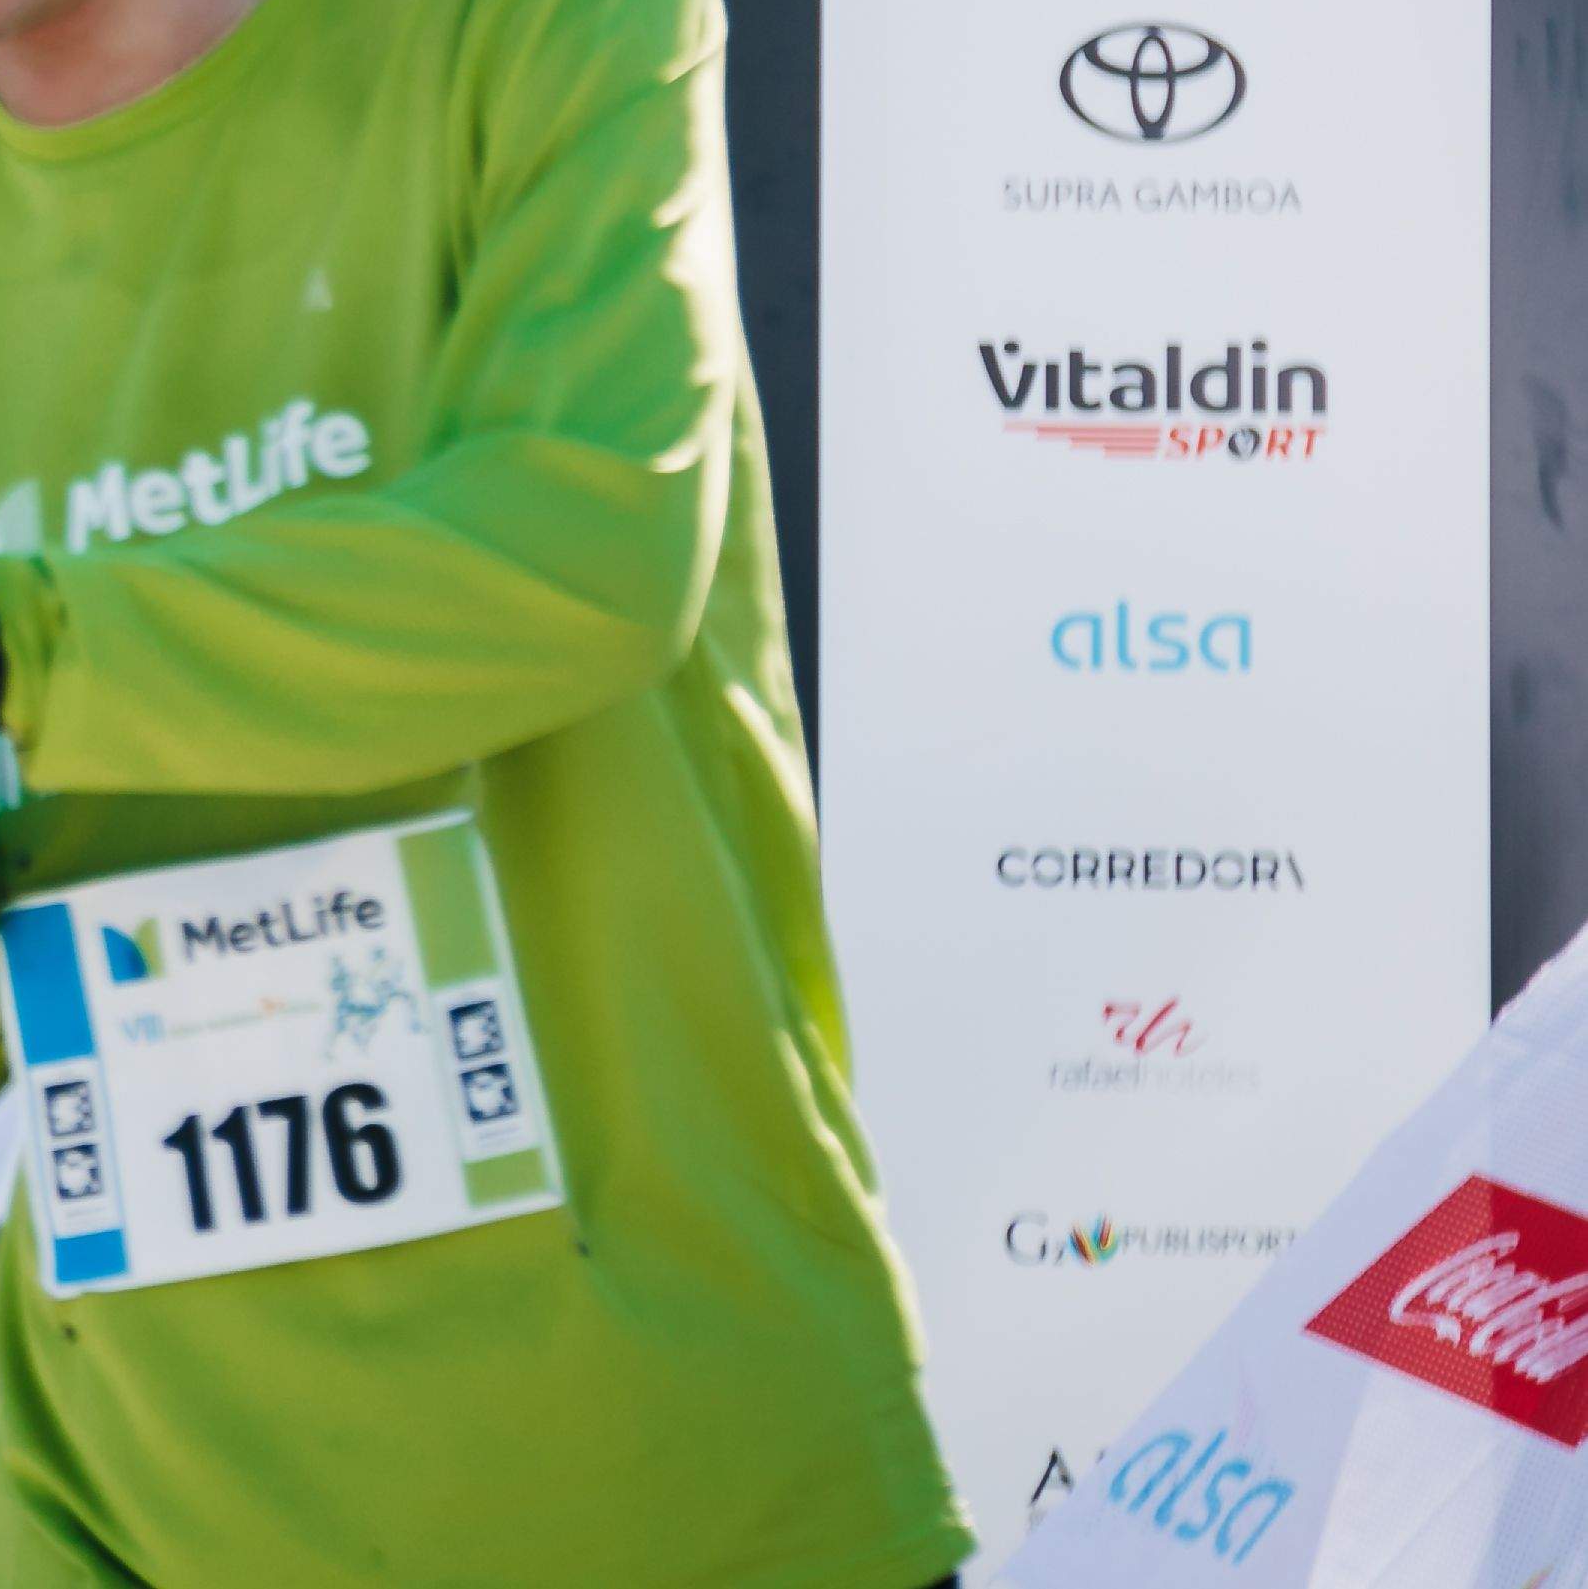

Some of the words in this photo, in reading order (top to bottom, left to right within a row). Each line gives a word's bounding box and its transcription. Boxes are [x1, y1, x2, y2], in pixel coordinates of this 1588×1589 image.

[1002, 178, 1122, 213] SUPRA
[1134, 178, 1303, 214] GAMBOA
[978, 338, 1329, 414] Vitaldin
[67, 398, 372, 551] MetLife
[1164, 425, 1322, 460] SPORT
[1049, 600, 1253, 673] alsa
[180, 891, 385, 962] MetLife
[162, 1081, 403, 1235] 1176
[1109, 1428, 1297, 1568] alsa
